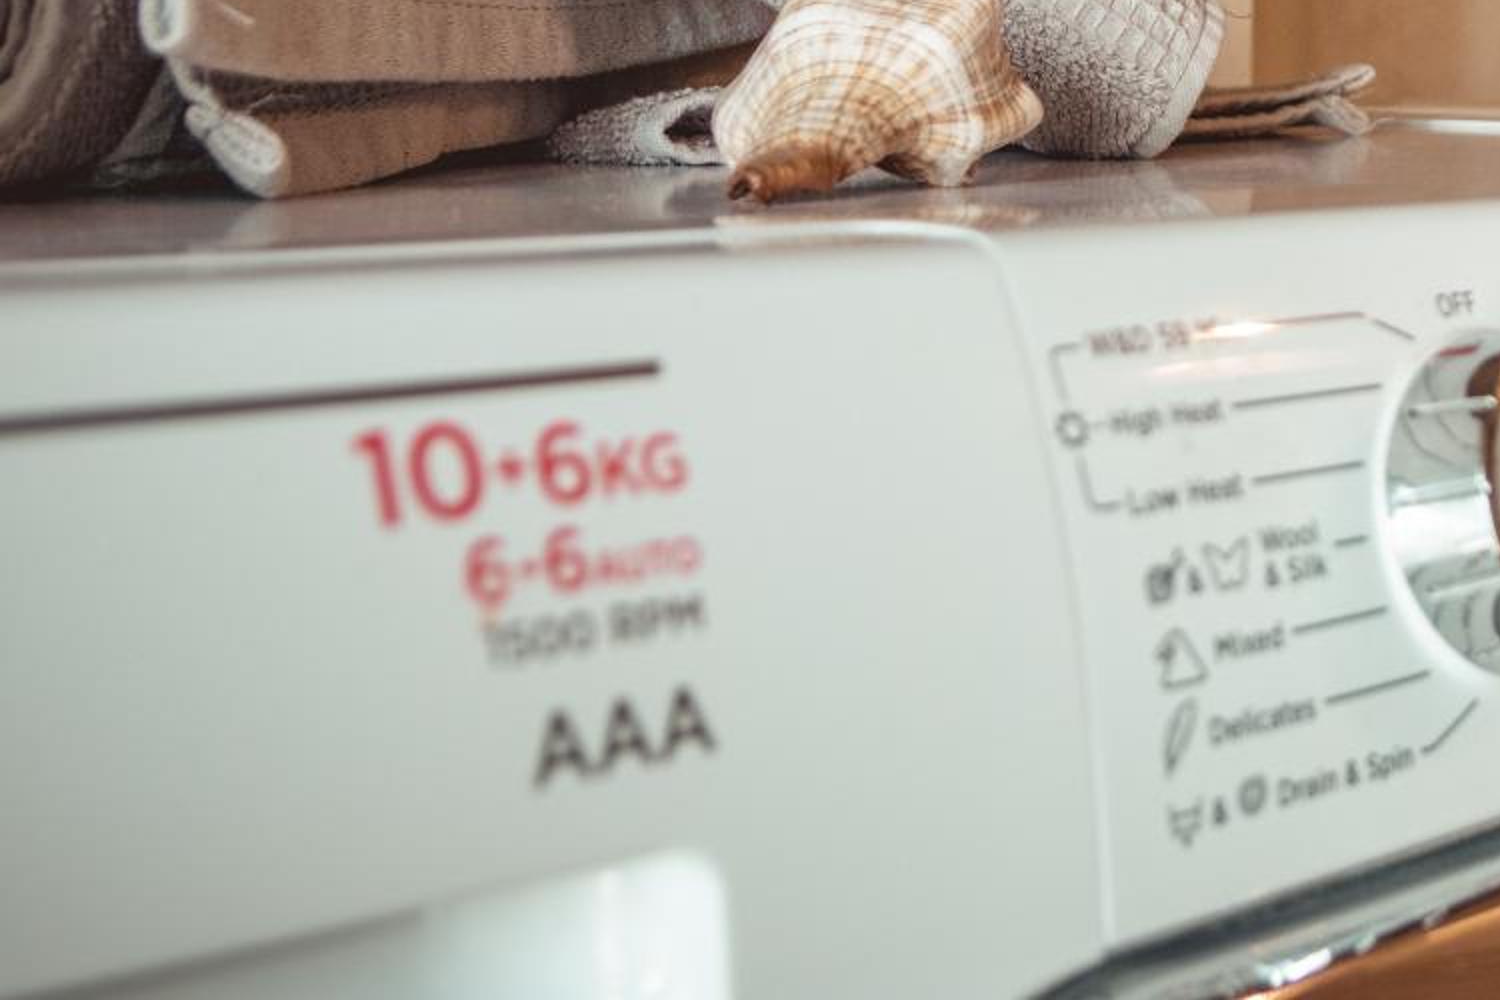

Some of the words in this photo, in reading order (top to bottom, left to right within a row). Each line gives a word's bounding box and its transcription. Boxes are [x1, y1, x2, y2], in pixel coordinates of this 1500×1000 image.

[1436, 290, 1475, 317] OFF
[1111, 405, 1163, 435] High
[1128, 490, 1178, 516] Low
[1187, 474, 1243, 502] Heat
[1258, 519, 1319, 551] Wool
[1212, 626, 1285, 659] Mixed
[533, 684, 718, 789] AAA
[1207, 701, 1316, 746] Delicates
[1276, 771, 1340, 806] Drain
[1365, 747, 1415, 783] Spin
